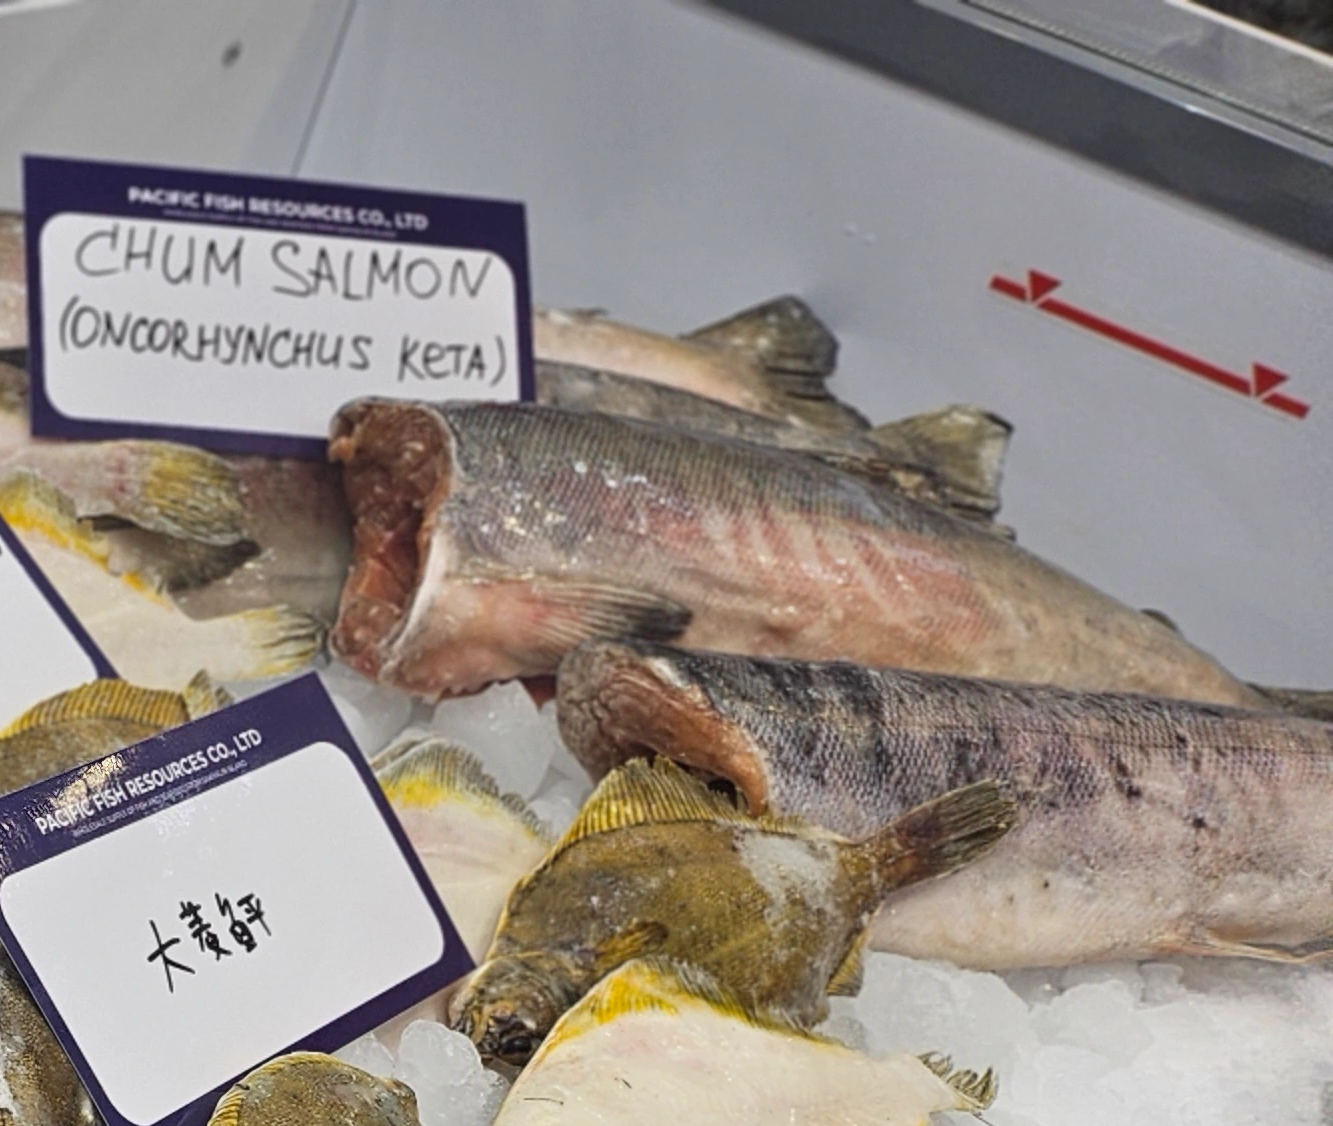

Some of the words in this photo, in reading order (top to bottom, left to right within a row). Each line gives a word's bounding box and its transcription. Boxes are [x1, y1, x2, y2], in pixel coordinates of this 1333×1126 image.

[128, 187, 201, 208] PACIFIC
[204, 192, 244, 212] FISH
[249, 196, 354, 222] RESOURCES
[395, 211, 429, 231] LTD
[75, 222, 245, 288] CHUM
[271, 239, 493, 301] SALMON
[59, 295, 373, 371] (ONCORHYNCHUS
[35, 798, 97, 836] PACIFIC
[92, 785, 127, 812] FISH
[125, 751, 209, 798] RESOURCES
[206, 741, 238, 763] CO.,
[234, 729, 263, 752] LTD
